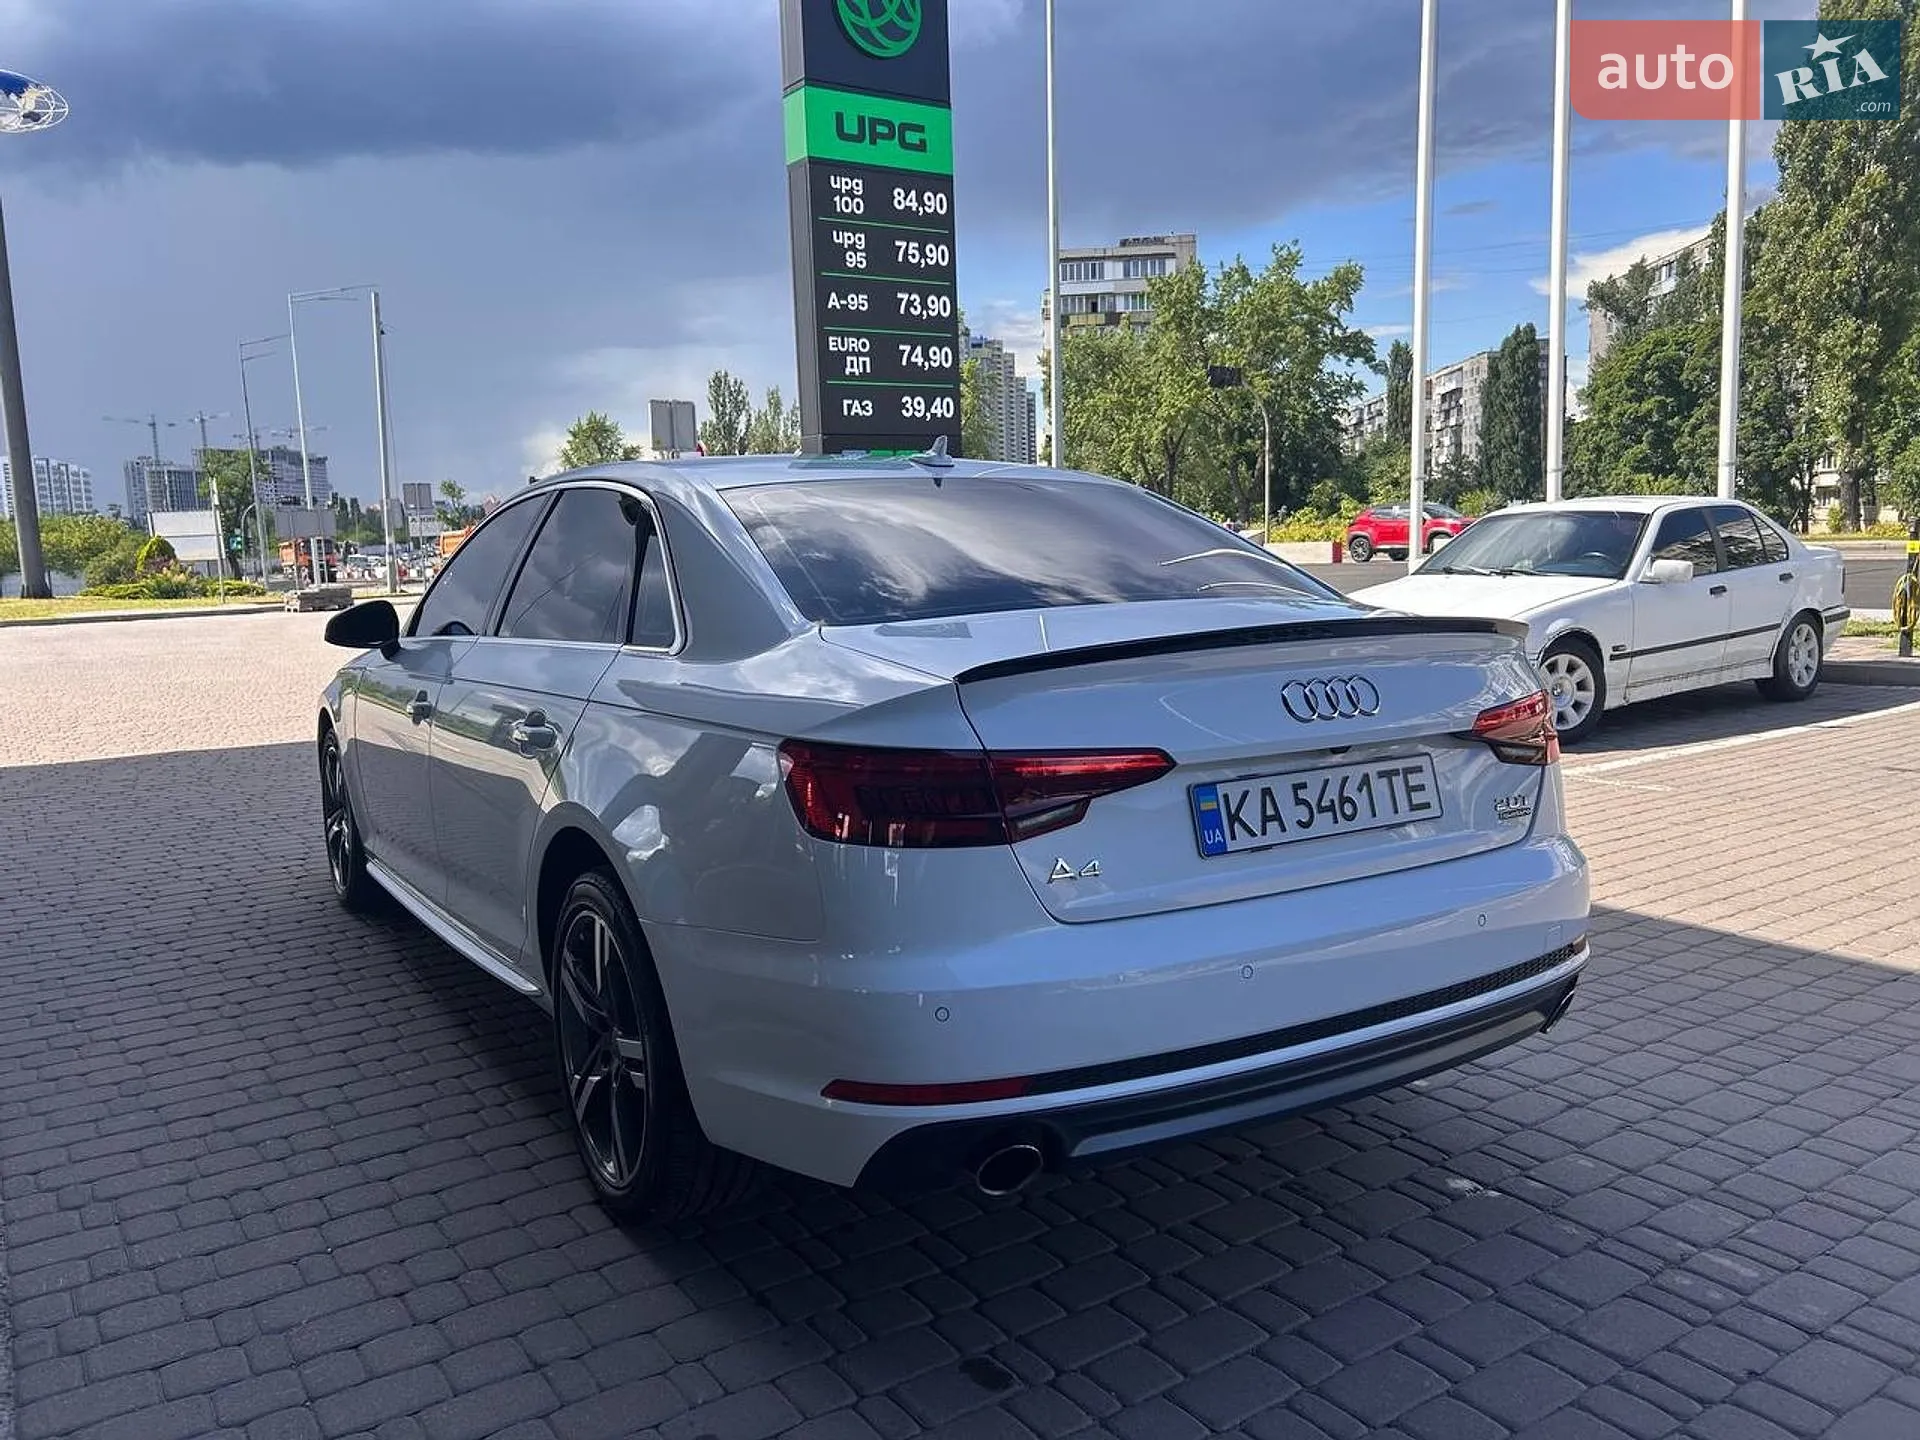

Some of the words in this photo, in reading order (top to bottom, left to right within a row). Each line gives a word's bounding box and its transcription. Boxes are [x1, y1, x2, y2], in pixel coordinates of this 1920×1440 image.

[835, 111, 928, 153] UPG
[830, 175, 864, 195] upg
[833, 196, 864, 215] 100
[893, 188, 948, 216] 84,90
[832, 229, 866, 249] upg
[845, 251, 867, 269] 95
[895, 240, 949, 268] 75,90
[827, 292, 869, 312] A-95
[897, 292, 951, 320] 73,90
[828, 336, 870, 352] EURO
[845, 356, 871, 376] ДП
[899, 344, 953, 371] 74,90
[842, 399, 873, 417] ГАЗ
[901, 395, 954, 421] 39,40
[1203, 828, 1224, 845] UA
[1047, 857, 1101, 884] A4
